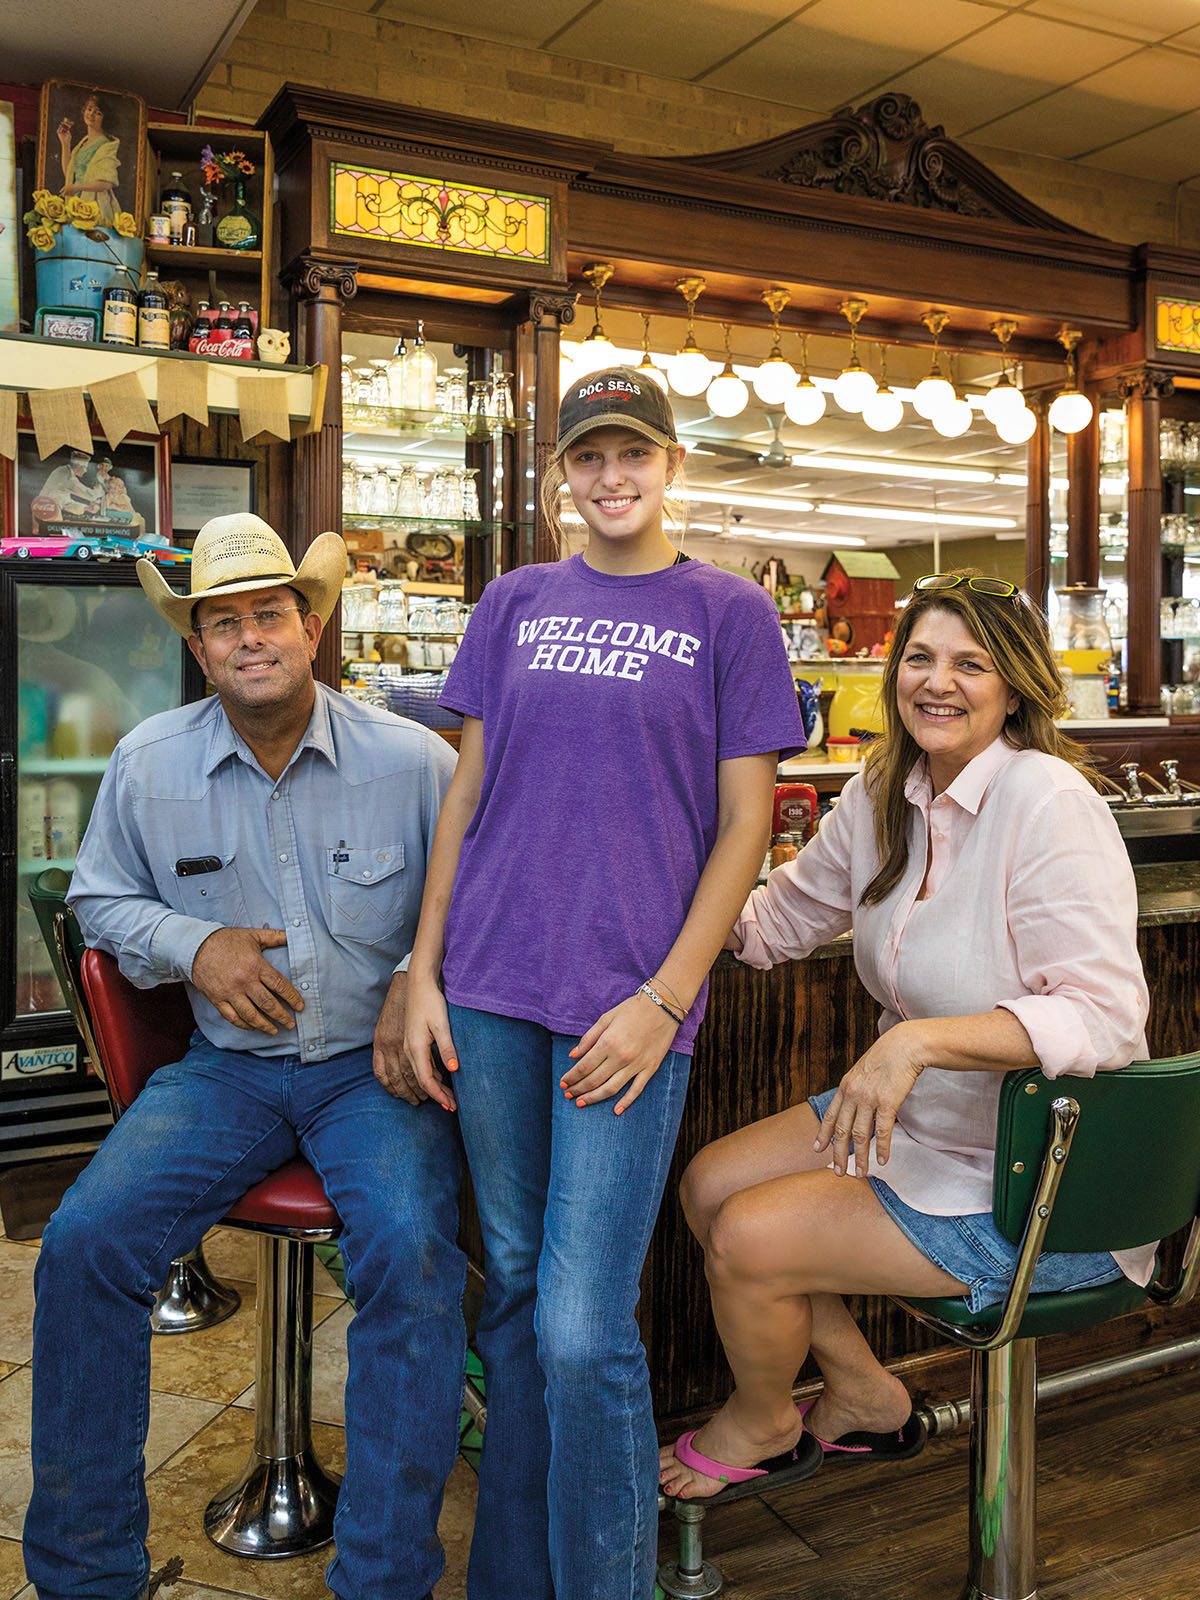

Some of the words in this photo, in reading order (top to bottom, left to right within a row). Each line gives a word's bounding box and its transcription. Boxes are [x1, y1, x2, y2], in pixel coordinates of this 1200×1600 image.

[196, 339, 248, 357] Coca-Cola
[578, 382, 604, 399] DOC
[607, 380, 641, 395] SEAS
[517, 616, 702, 667] WELCOME
[528, 644, 649, 682] HOME
[4, 1051, 75, 1073] AVANTCO
